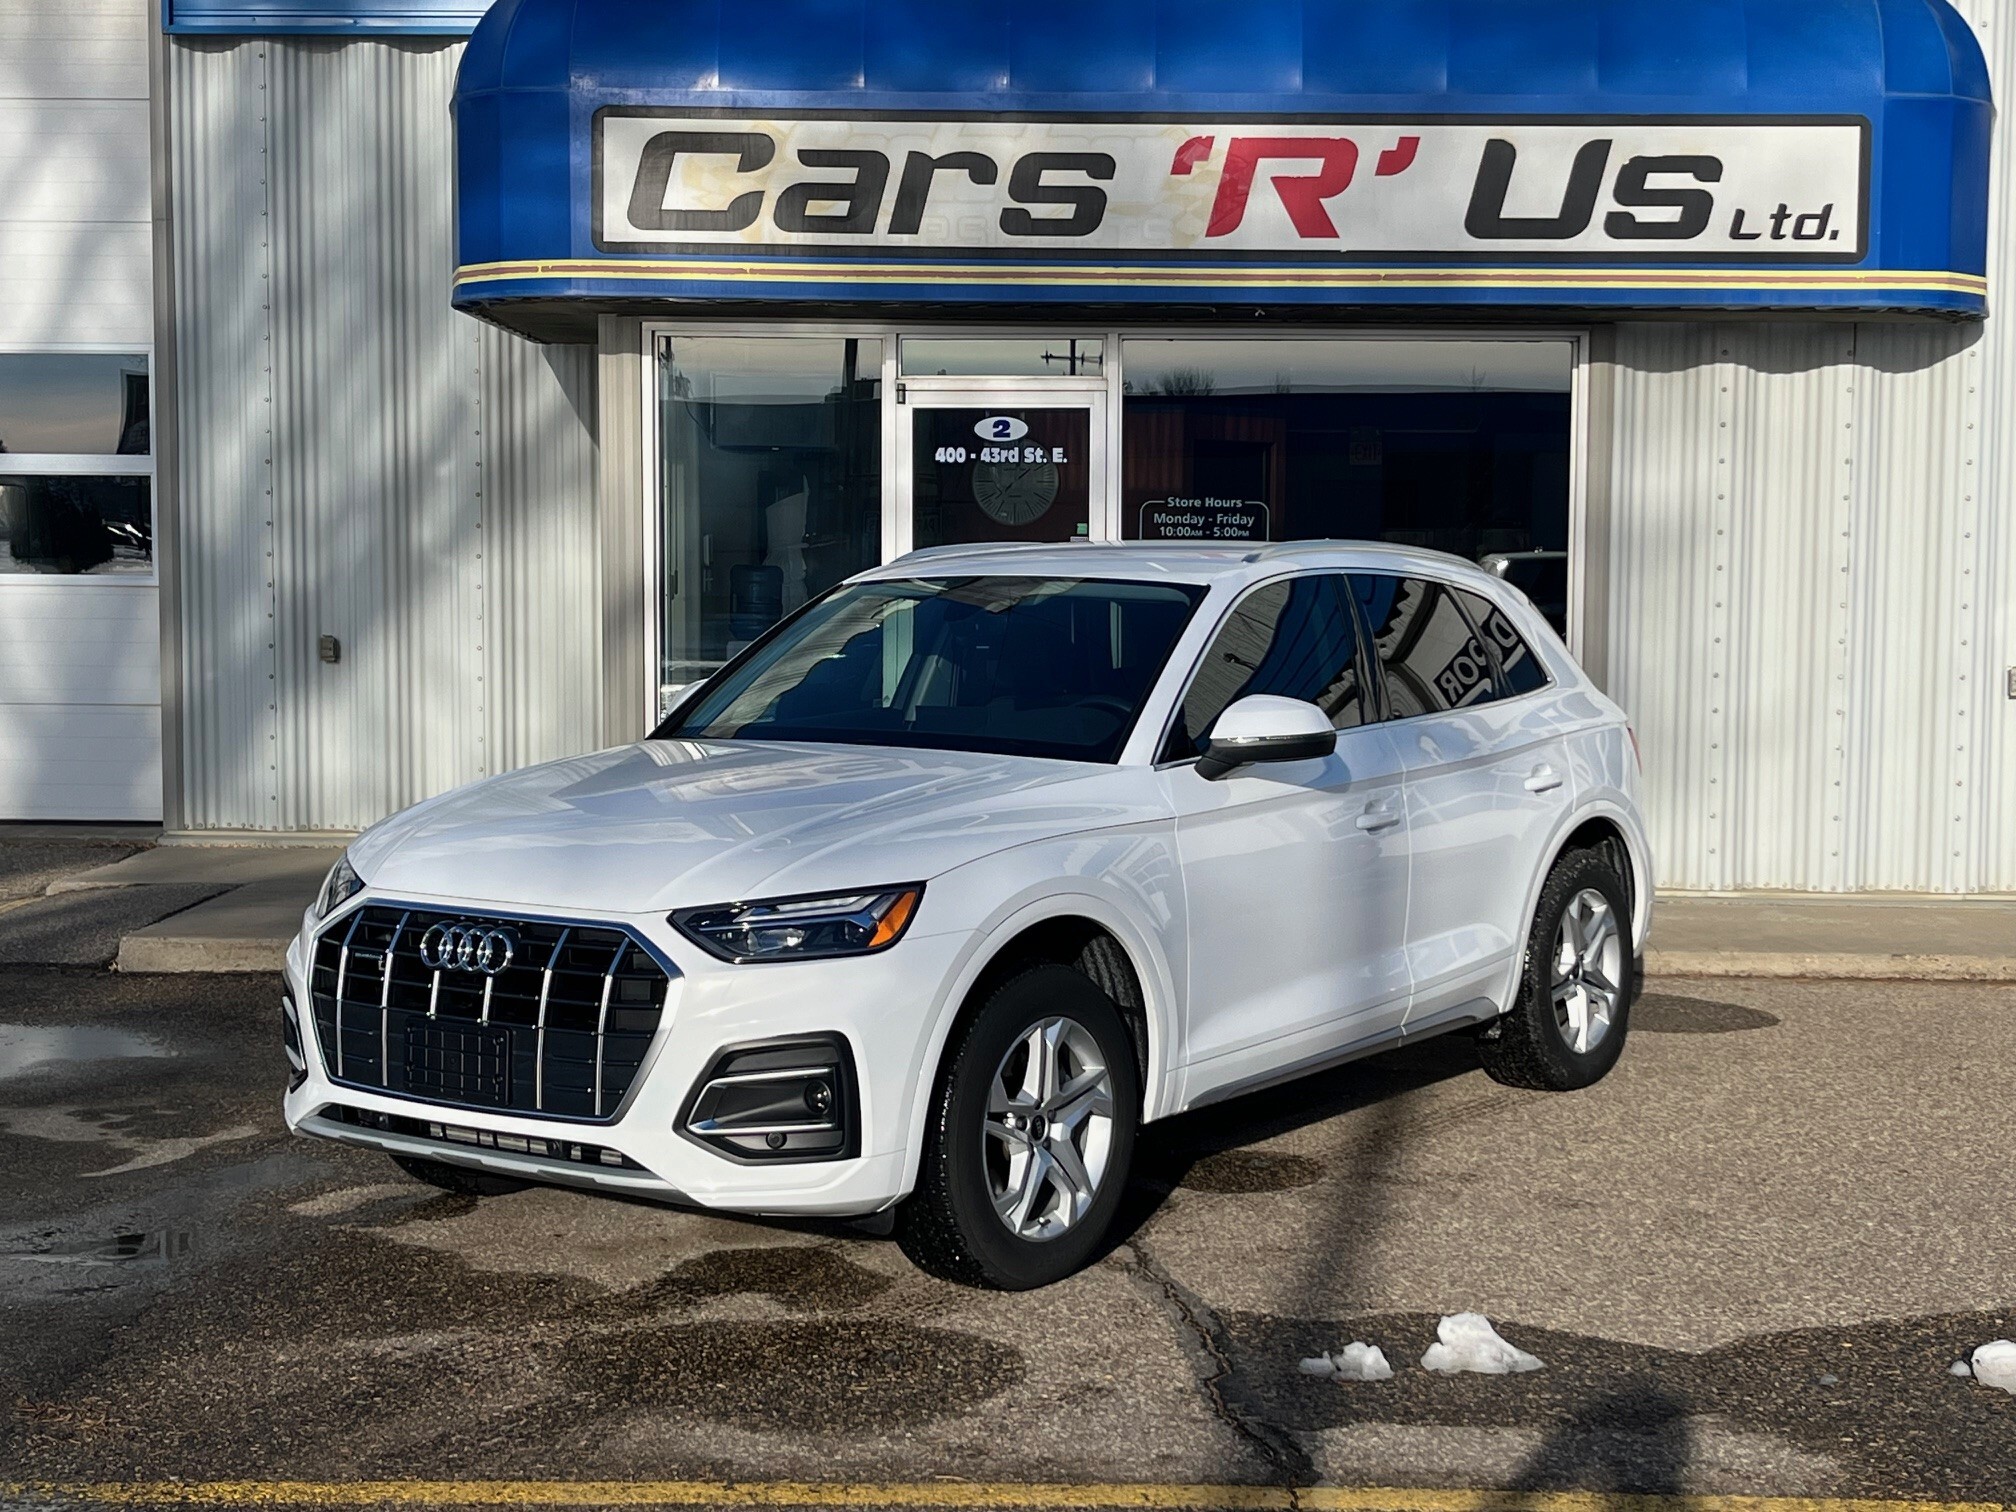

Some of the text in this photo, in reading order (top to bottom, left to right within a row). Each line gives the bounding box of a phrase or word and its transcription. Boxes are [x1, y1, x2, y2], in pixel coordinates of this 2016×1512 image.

[626, 131, 1116, 236] Cars
[1464, 139, 1723, 240] Us
[1728, 203, 1840, 240] Ltd.
[993, 420, 1011, 438] 2
[935, 447, 966, 463] 400
[981, 447, 1019, 463] 43rd
[1024, 447, 1047, 463] St.
[1052, 447, 1068, 463] E.
[1167, 497, 1242, 508] Store Hours
[1153, 513, 1205, 526] Monday
[1216, 513, 1254, 527] Friday
